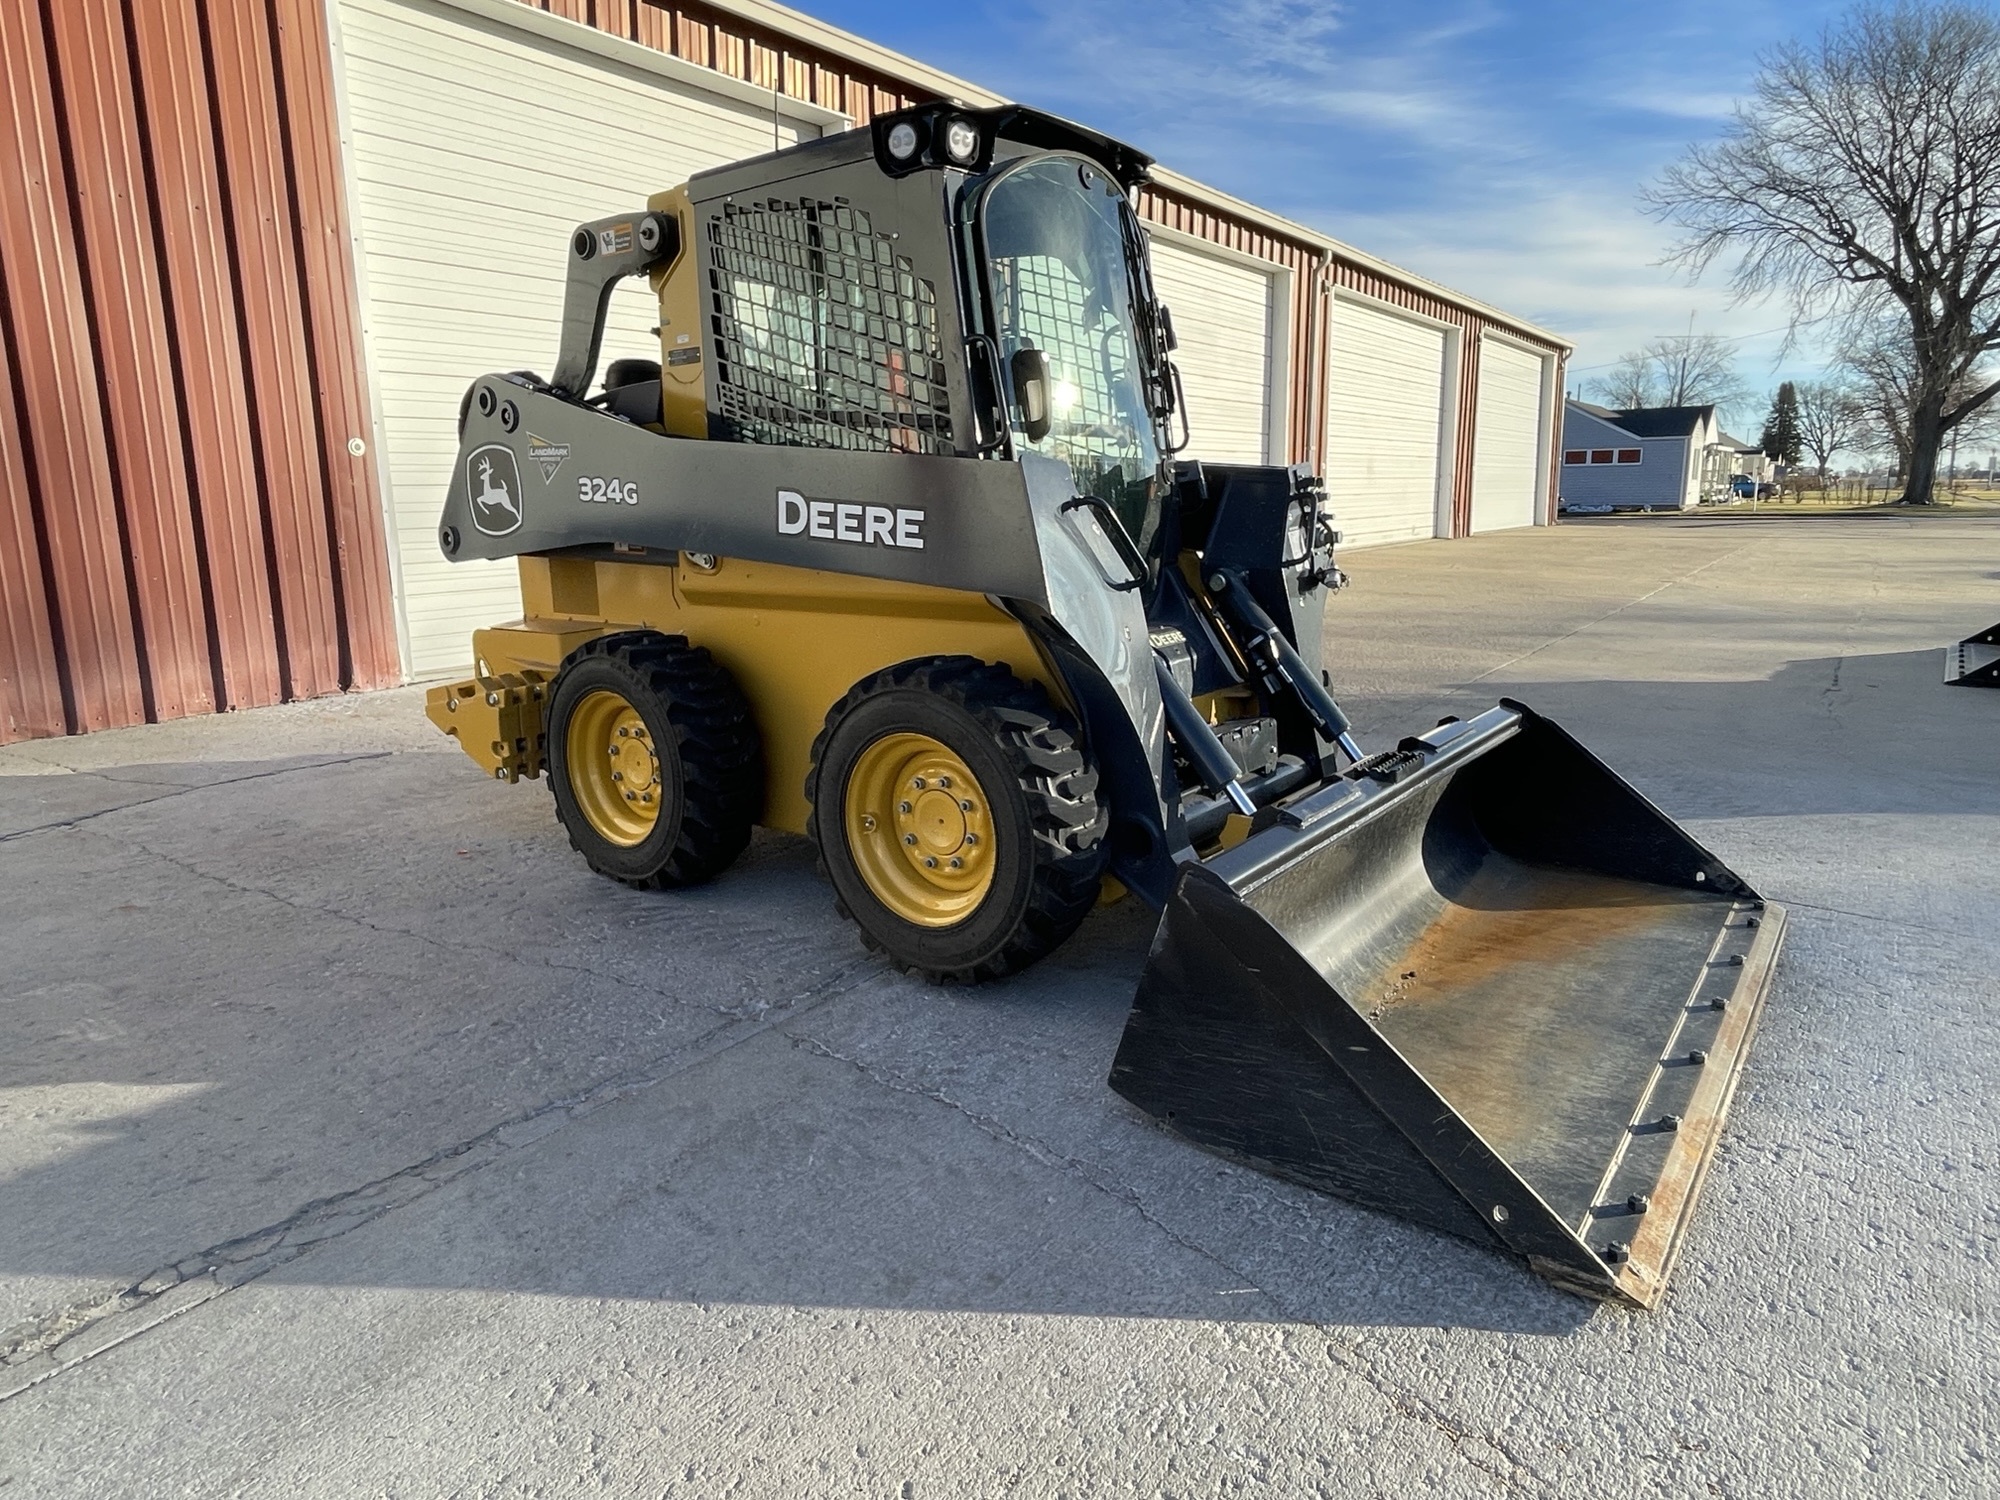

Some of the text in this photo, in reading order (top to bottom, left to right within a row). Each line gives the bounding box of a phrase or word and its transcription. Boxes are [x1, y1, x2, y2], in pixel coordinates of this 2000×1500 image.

[578, 477, 638, 505] 324G
[778, 490, 925, 549] DEERE
[1150, 631, 1186, 647] DEERE
